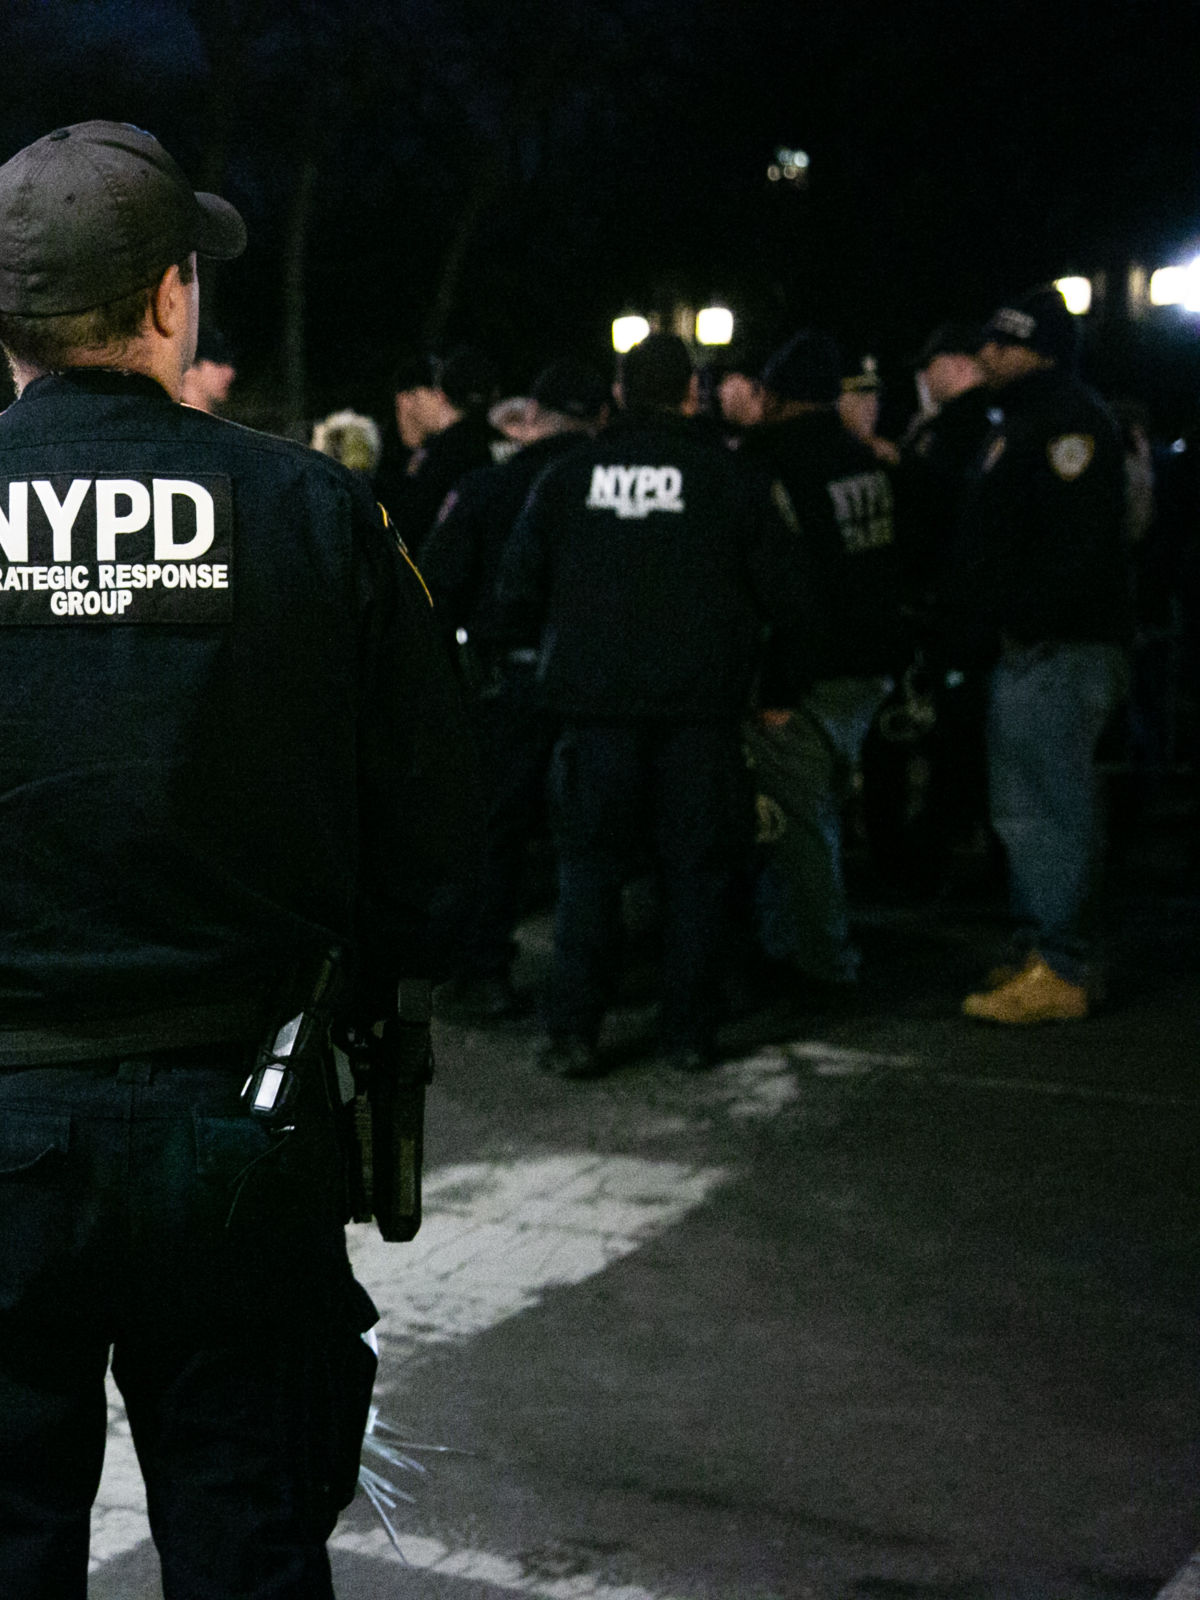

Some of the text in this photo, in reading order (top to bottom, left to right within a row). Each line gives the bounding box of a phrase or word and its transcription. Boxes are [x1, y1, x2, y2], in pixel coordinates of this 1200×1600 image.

[590, 464, 682, 502] NYPD
[99, 564, 229, 589] RESPONSE
[50, 590, 133, 616] GROUP
